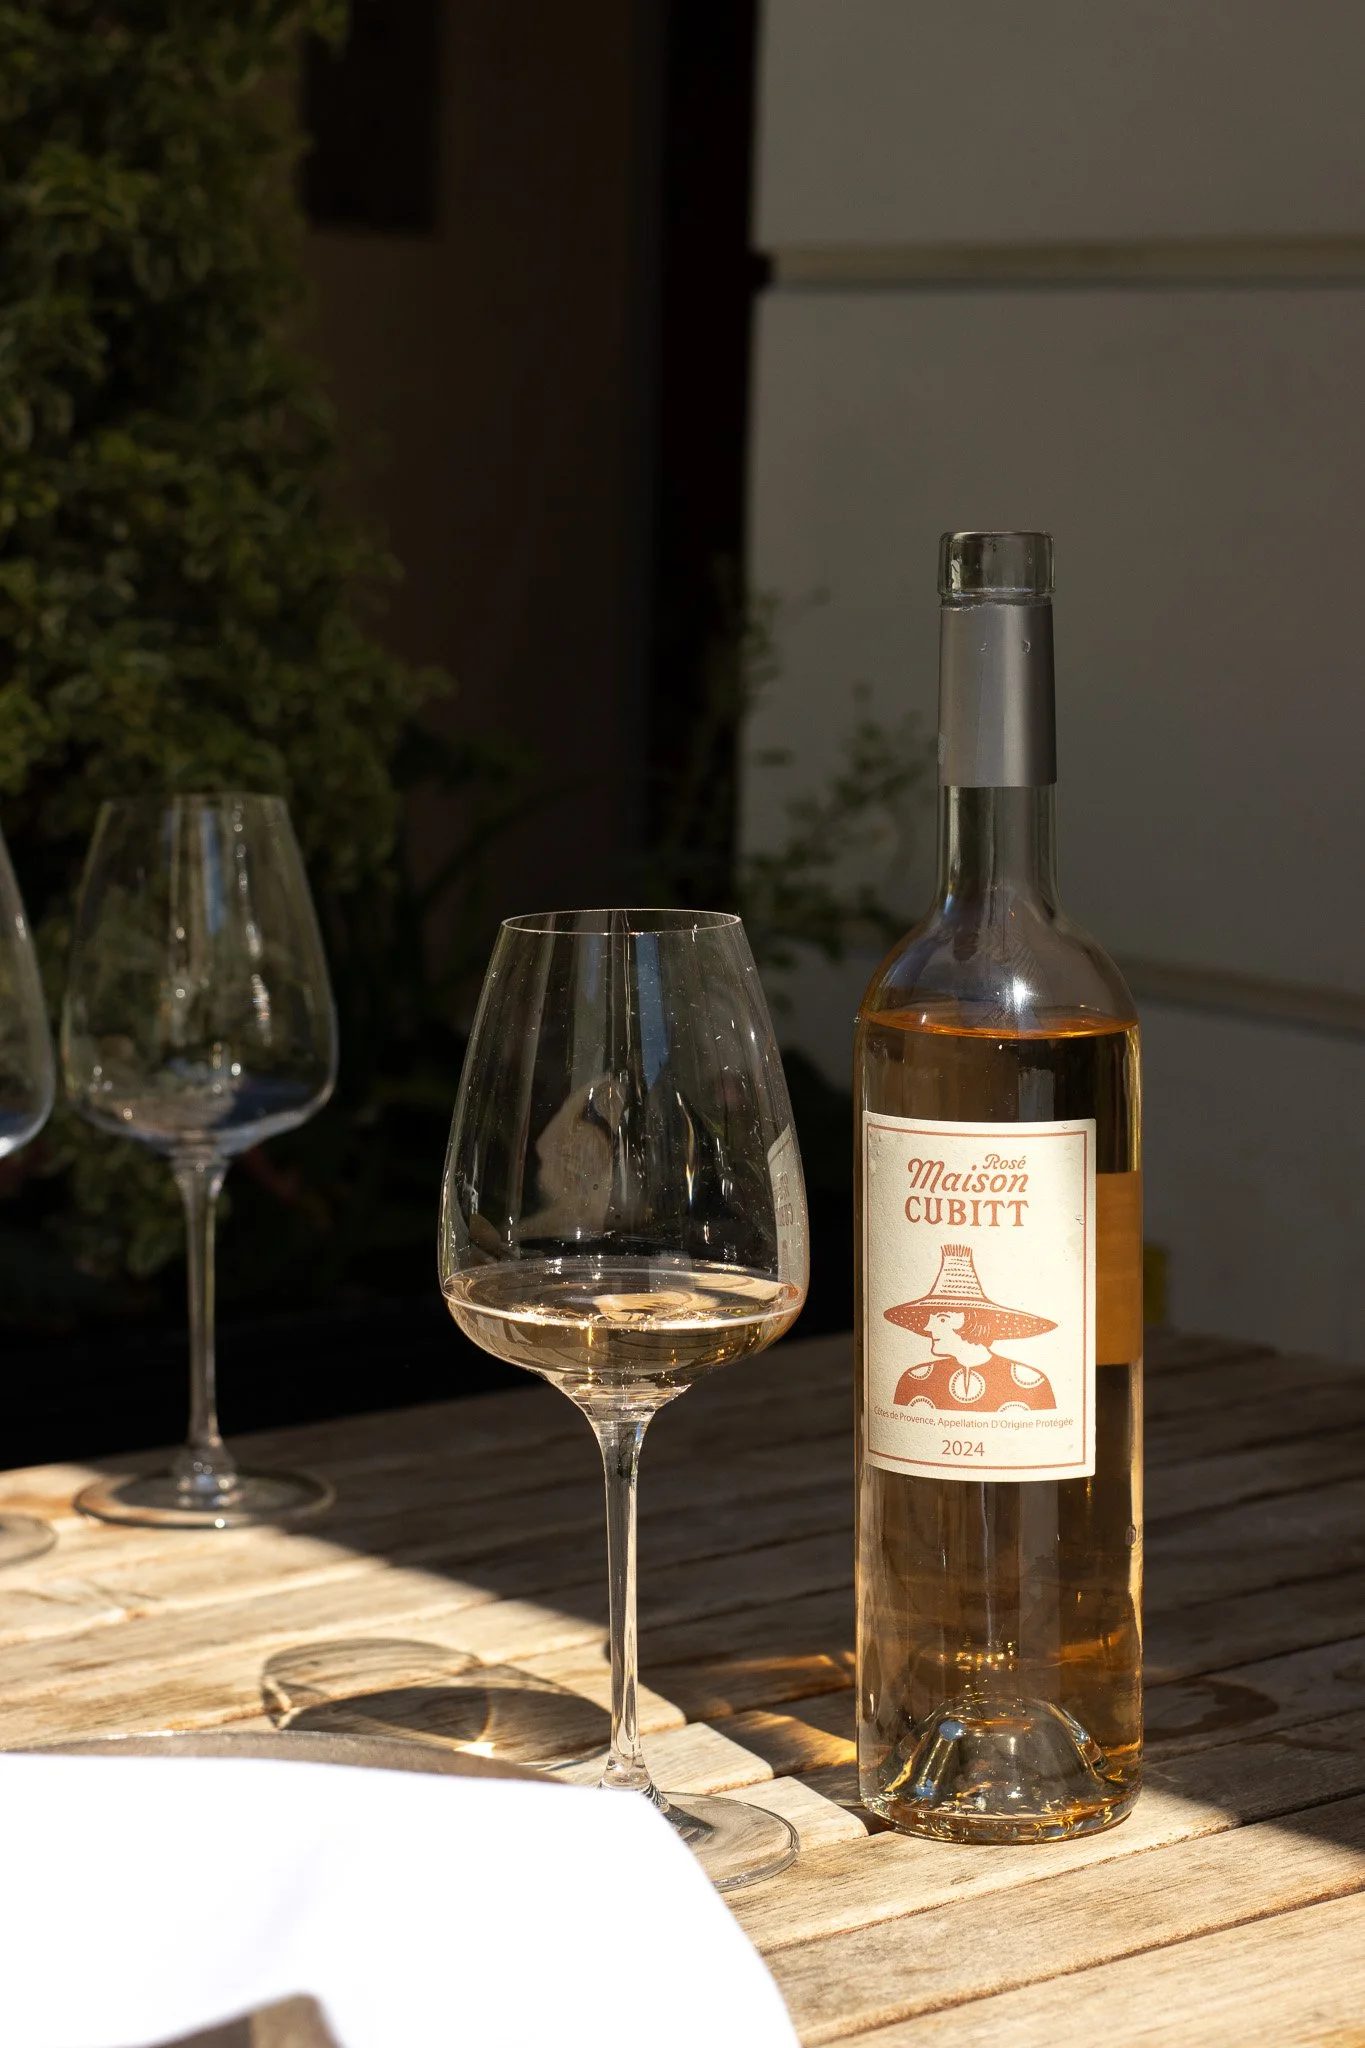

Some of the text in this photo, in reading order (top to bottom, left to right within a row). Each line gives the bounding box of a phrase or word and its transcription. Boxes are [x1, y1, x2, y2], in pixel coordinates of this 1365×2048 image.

[982, 1153, 1026, 1170] Rosé
[907, 1158, 1029, 1193] Maison
[904, 1195, 1029, 1227] CUBITT
[890, 1411, 899, 1420] de
[899, 1412, 936, 1426] Provence,
[937, 1417, 989, 1429] Appellation
[941, 1439, 985, 1457] 2024
